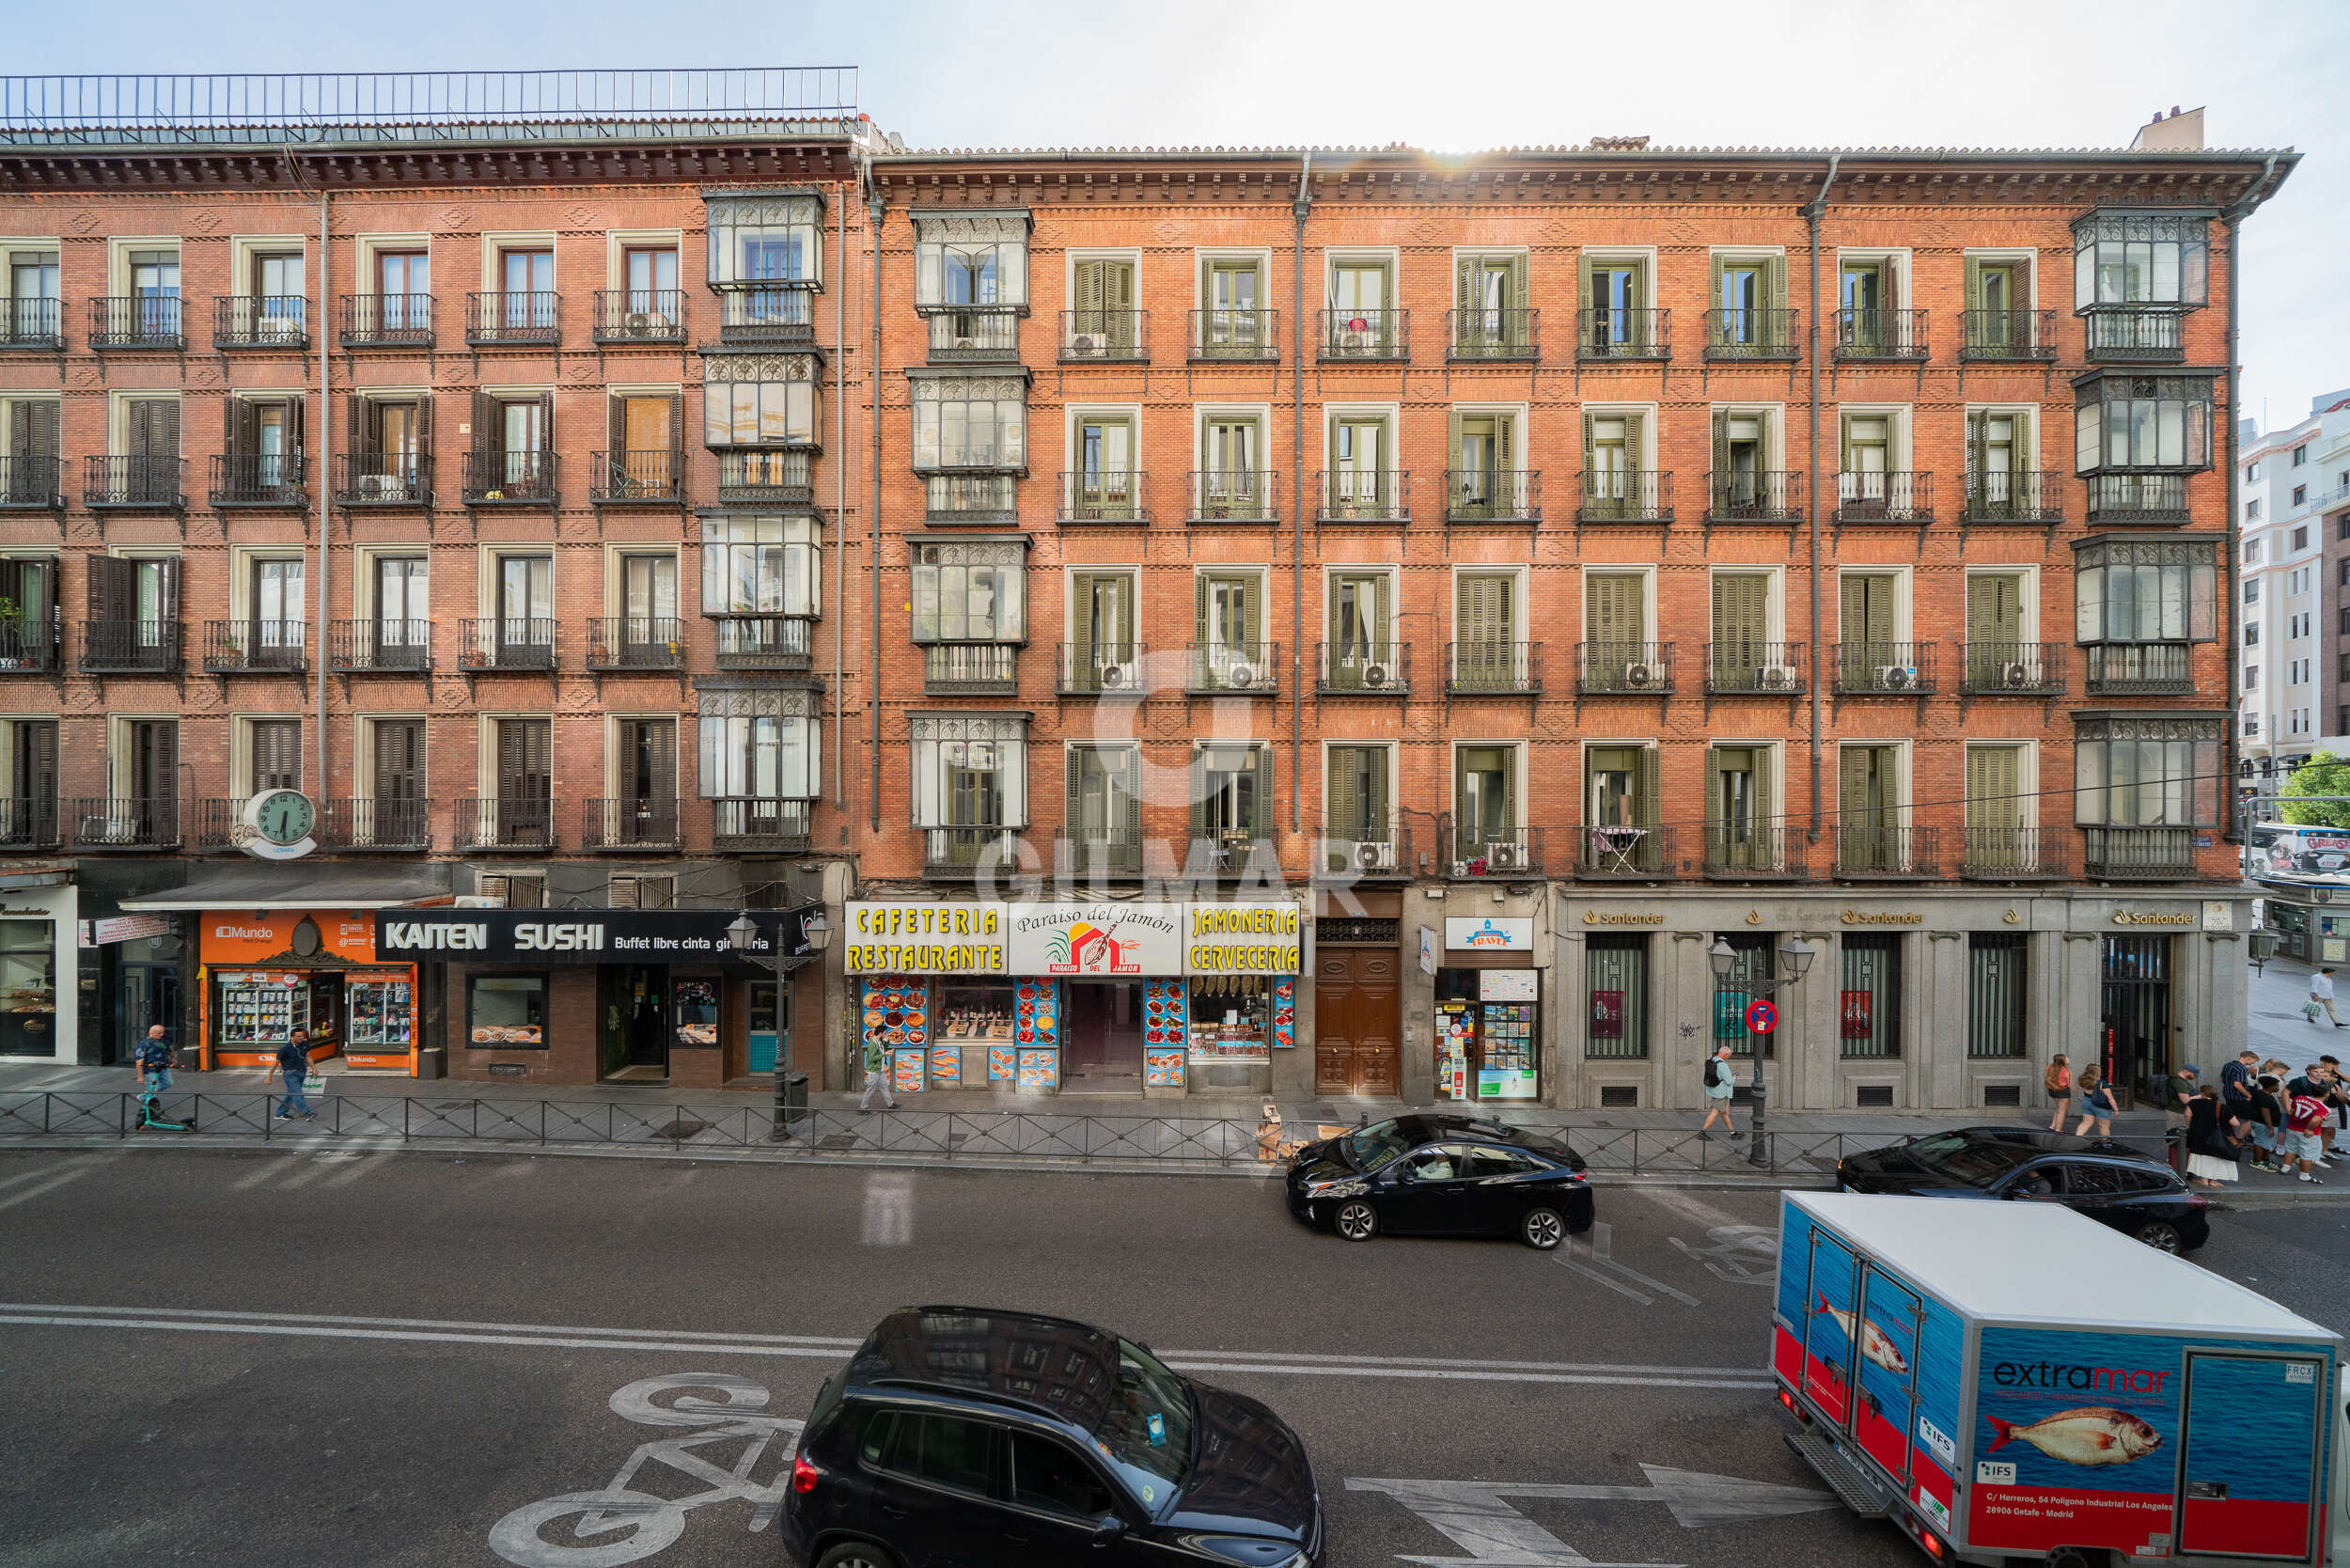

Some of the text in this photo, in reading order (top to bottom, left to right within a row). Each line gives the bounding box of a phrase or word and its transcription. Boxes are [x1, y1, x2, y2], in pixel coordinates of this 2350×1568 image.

[856, 909, 998, 935] CAFETERIA
[1017, 904, 1174, 933] Paraiso del Jamón
[1192, 908, 1297, 938] JAMONERIA
[1601, 911, 1667, 925] Santander
[1858, 912, 1923, 925] Santander
[2131, 912, 2198, 925] Santander
[231, 926, 274, 938] Mundo
[385, 922, 604, 950] KAITEN SUSHI
[615, 936, 769, 952] Buffet libre cinta girria
[848, 945, 1003, 971] RESTAURANTE
[1190, 945, 1298, 971] CERVECERIA
[2295, 1103, 2313, 1120] 17
[1993, 1360, 2171, 1393] extramar
[1933, 1431, 1951, 1451] IFS
[1992, 1466, 2012, 1476] IFS
[1999, 1493, 2036, 1504] Herreros,
[2086, 1498, 2124, 1508] Industrial
[2125, 1500, 2140, 1509] Los
[1985, 1506, 2013, 1514] 28906
[2013, 1507, 2040, 1516] Getafe
[2045, 1510, 2074, 1518] Madrid
